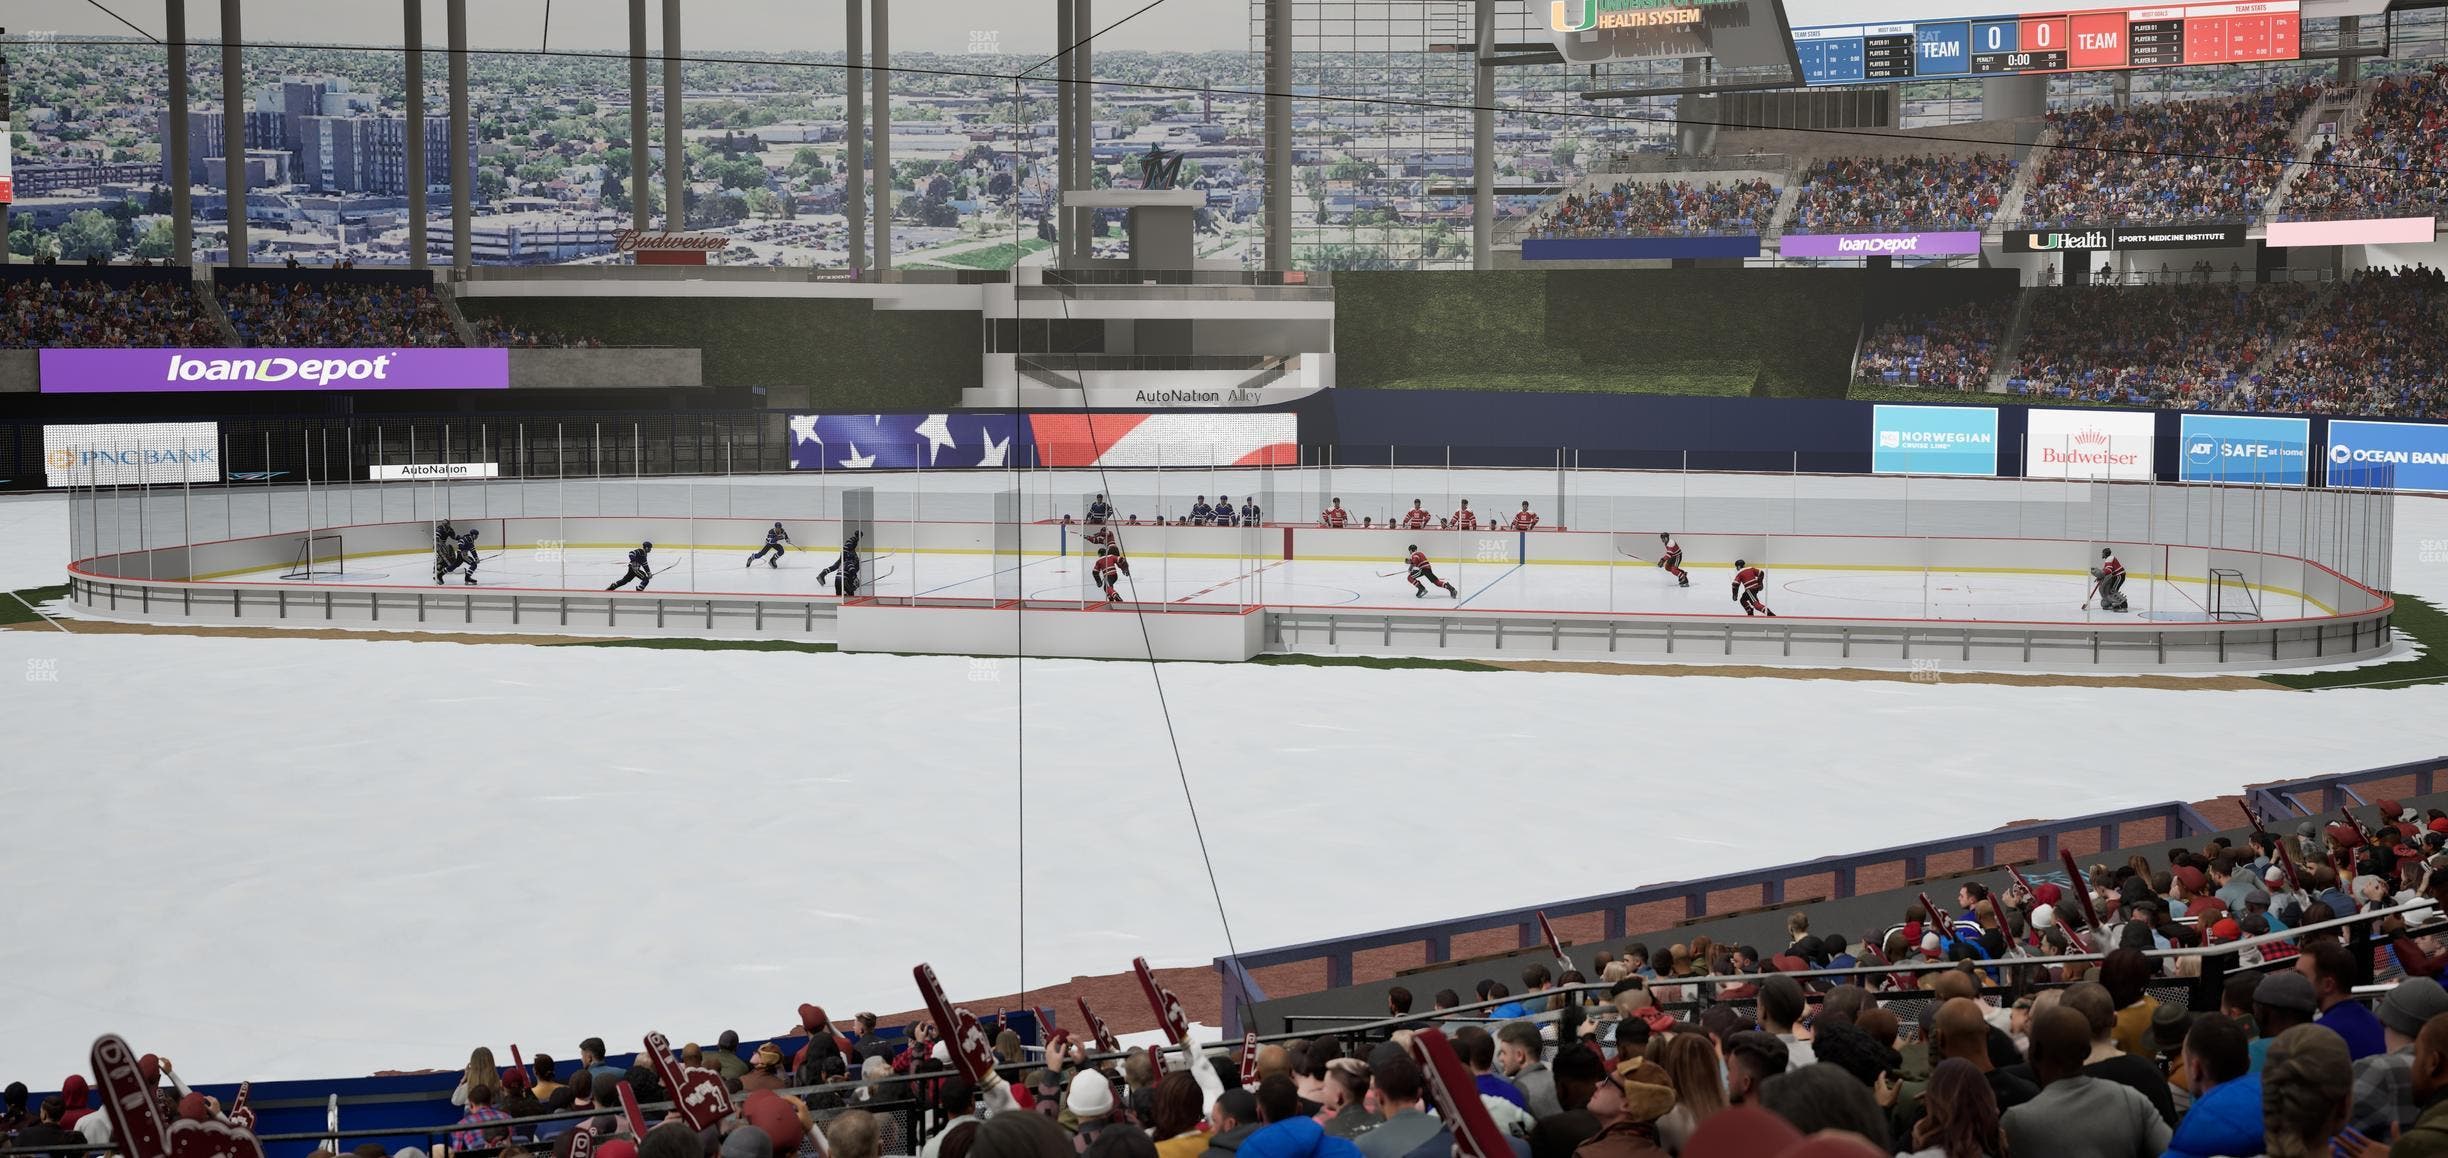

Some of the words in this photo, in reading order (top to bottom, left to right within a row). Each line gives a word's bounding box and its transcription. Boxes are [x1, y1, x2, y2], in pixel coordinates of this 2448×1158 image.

[1599, 13, 1647, 29] HEALTH
[1649, 9, 1700, 25] SYSTEM
[1988, 26, 2001, 50] 0
[2037, 23, 2050, 47] 0
[2078, 32, 2117, 50] TEAM
[1922, 41, 1960, 58] TEAM
[2008, 53, 2030, 66] 0:00
[611, 228, 729, 251] Budweiser
[1838, 236, 1918, 253] loanDepot
[2118, 235, 2147, 243] SPORTS
[2148, 234, 2185, 242] MEDICINE
[2185, 233, 2225, 241] INSTITUTE
[167, 354, 391, 386] loanDepot
[1136, 389, 1219, 402] AutoNation
[1228, 389, 1262, 404] Alley
[1902, 431, 1991, 443] NORWEGIAN
[2042, 447, 2138, 465] Budweiser
[2190, 443, 2213, 455] ADT
[2221, 443, 2269, 458] SAFE
[2280, 449, 2304, 457] home
[2353, 449, 2408, 464] OCEAN
[2411, 451, 2448, 465] BAN
[401, 465, 467, 475] AutoNation
